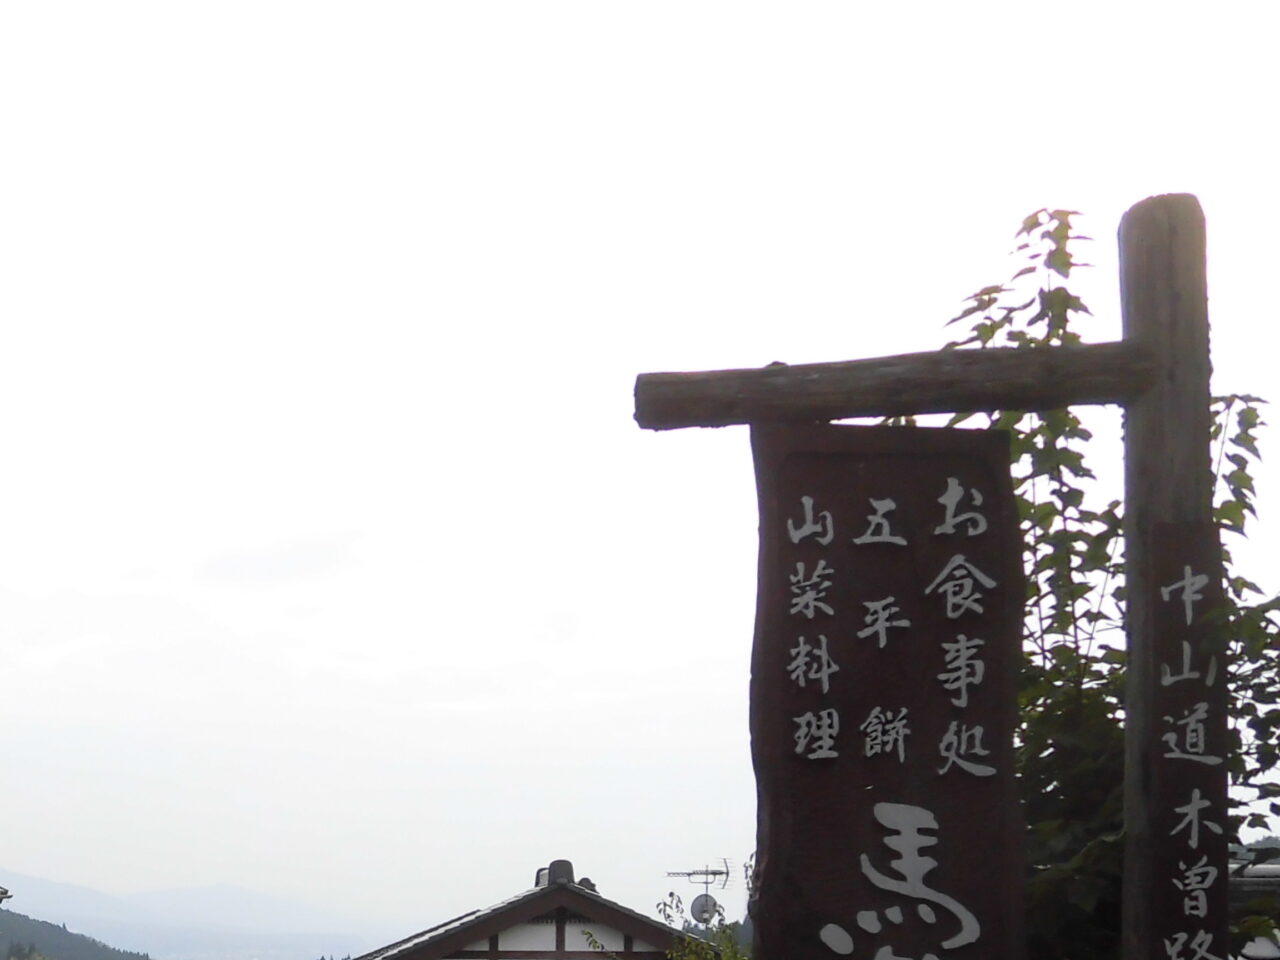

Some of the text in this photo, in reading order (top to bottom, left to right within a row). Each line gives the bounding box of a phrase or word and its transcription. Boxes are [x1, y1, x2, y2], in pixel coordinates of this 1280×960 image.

[786, 495, 840, 761] 山菜料理
[852, 498, 911, 763] 五平餅
[924, 477, 997, 777] お食事処
